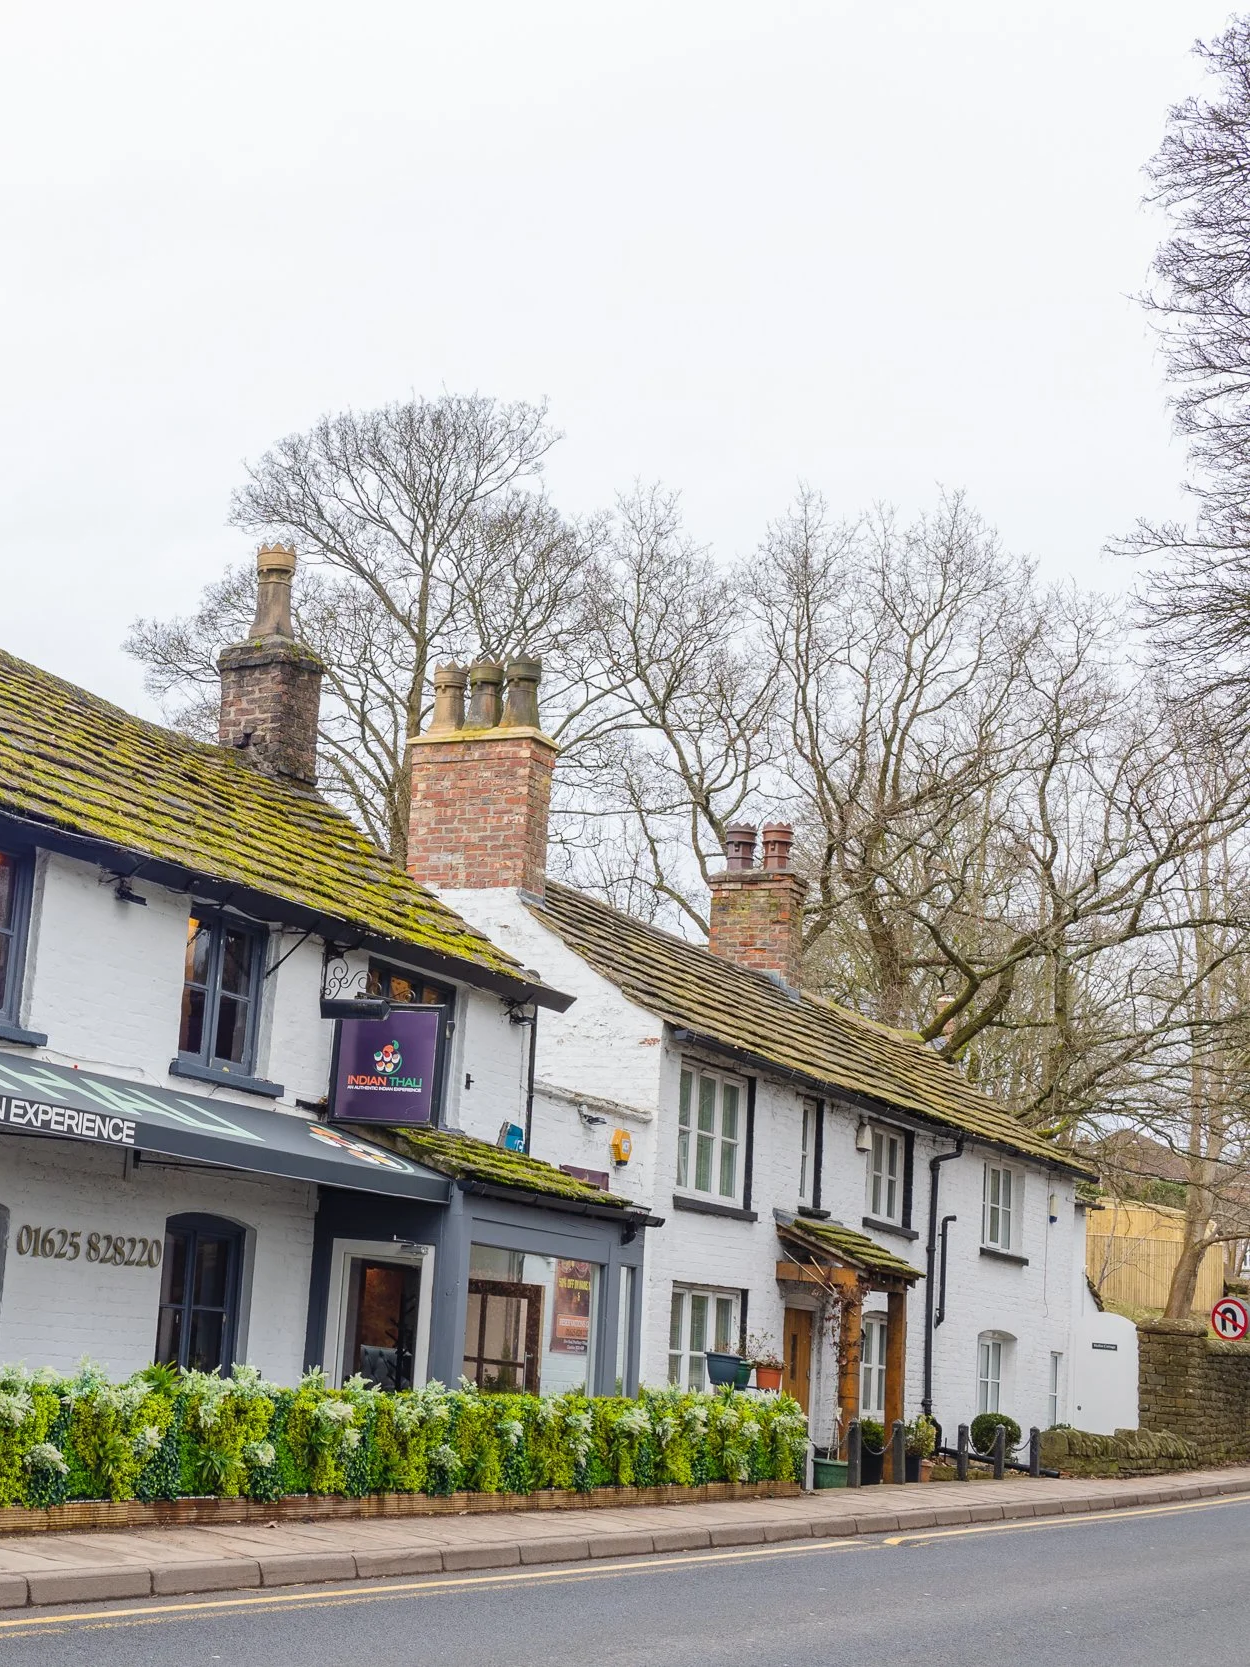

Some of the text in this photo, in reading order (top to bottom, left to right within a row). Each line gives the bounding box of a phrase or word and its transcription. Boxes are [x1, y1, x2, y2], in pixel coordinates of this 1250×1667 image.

[347, 1075, 422, 1088] INDIAN THALI
[9, 1099, 136, 1144] EXPERIENCE
[16, 1224, 162, 1268] 01625 828220
